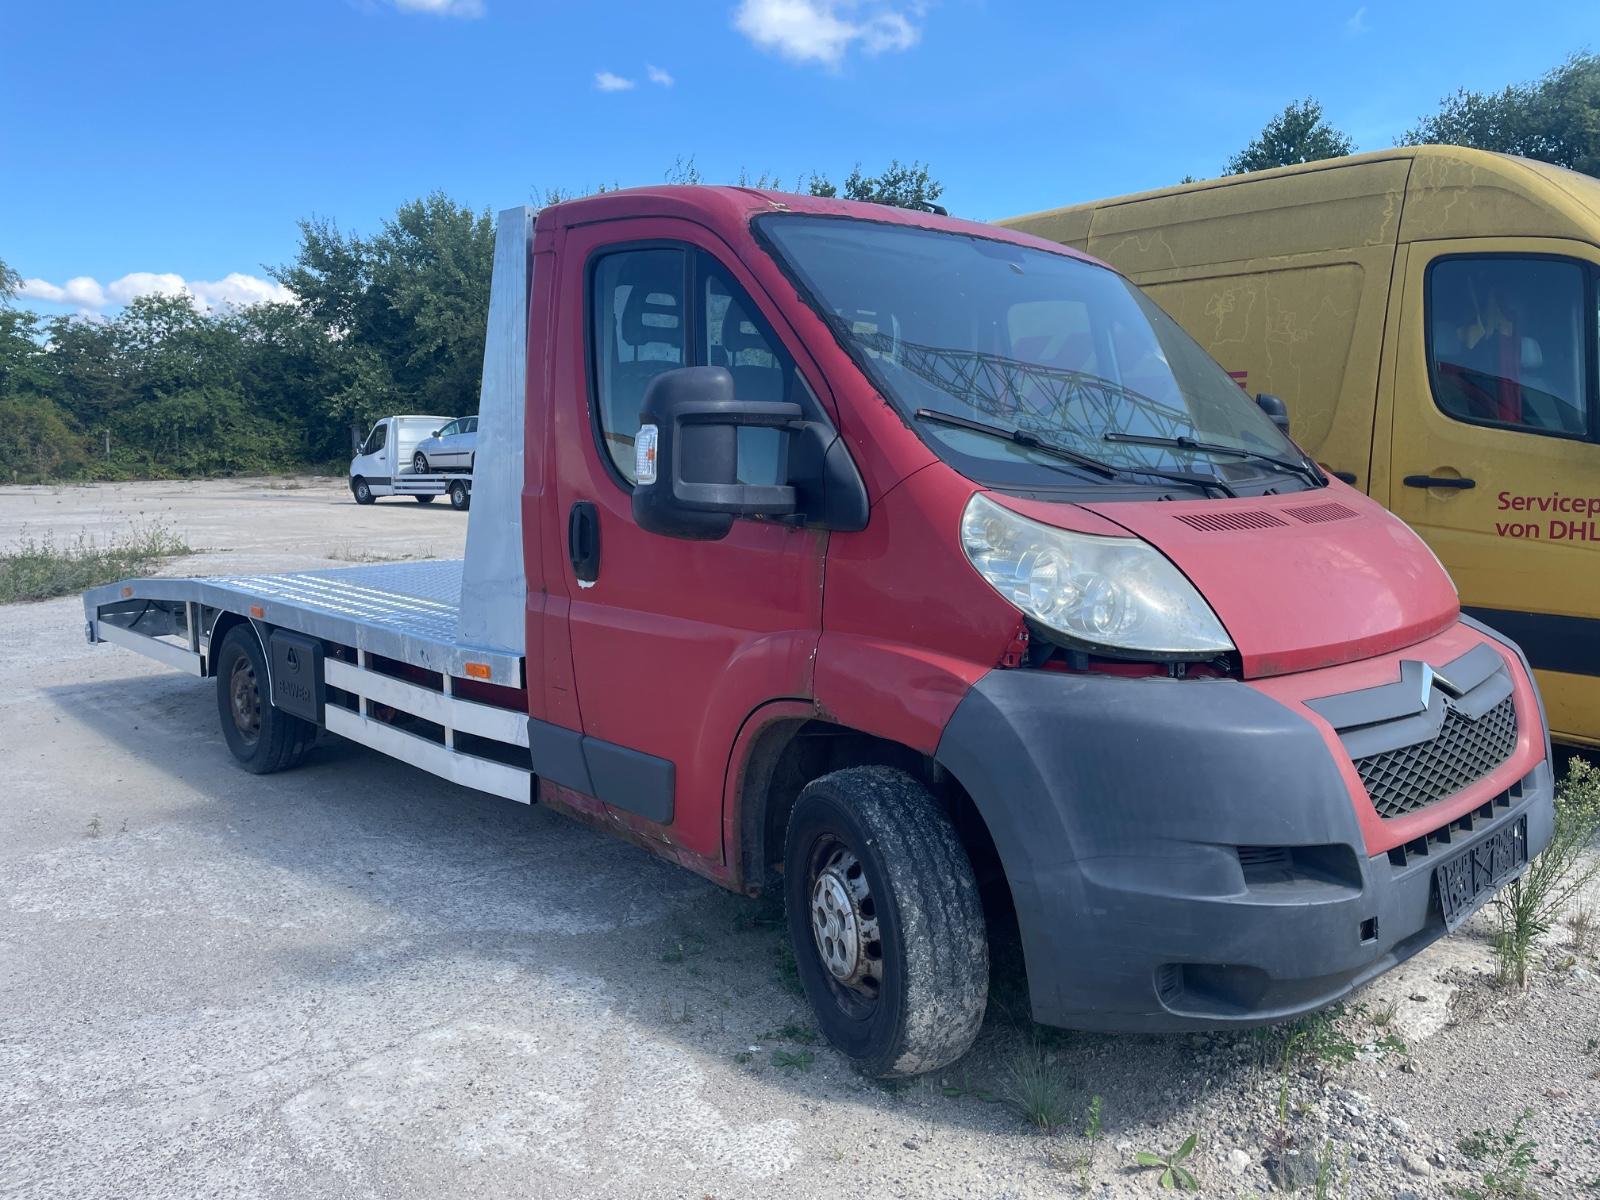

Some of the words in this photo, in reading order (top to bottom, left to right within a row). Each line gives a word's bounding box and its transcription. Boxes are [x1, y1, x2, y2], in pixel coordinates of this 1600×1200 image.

[1497, 491, 1600, 518] Servicep
[1495, 522, 1540, 539] von
[1549, 520, 1600, 541] DHL
